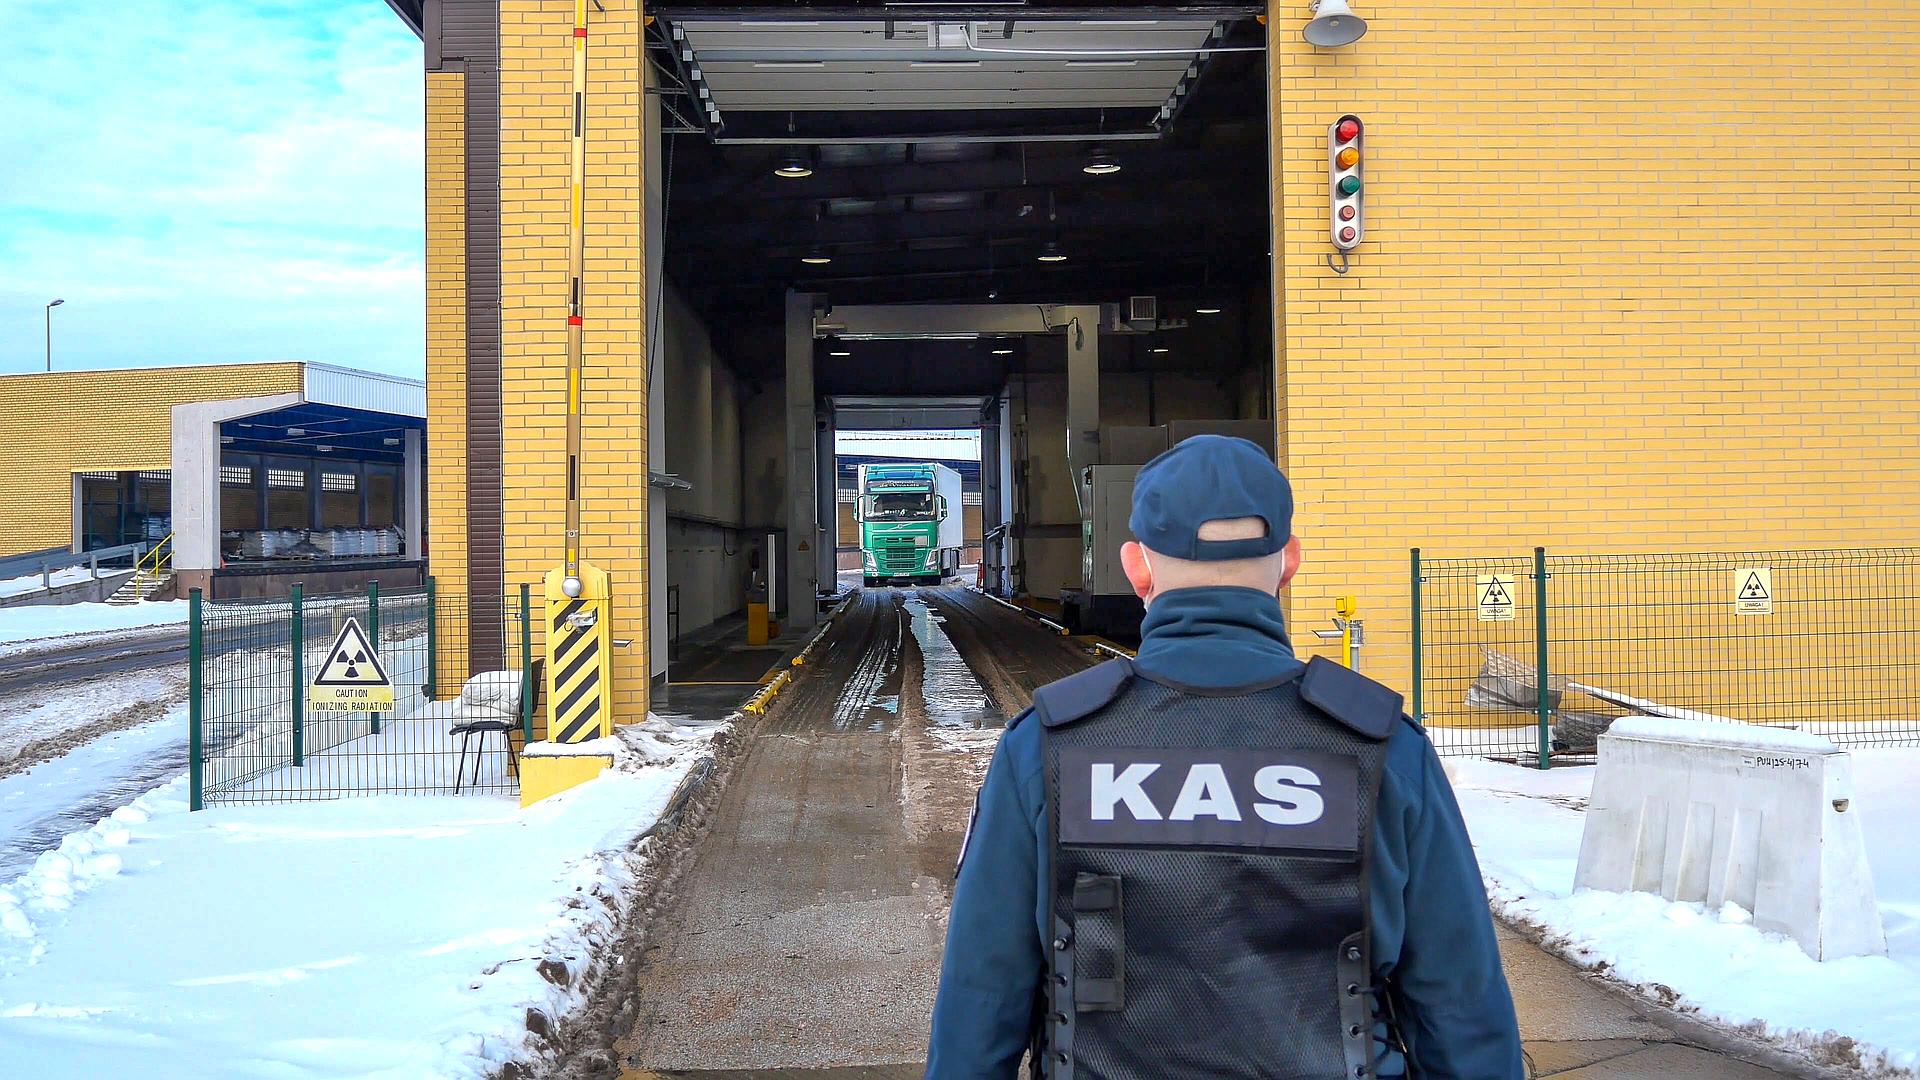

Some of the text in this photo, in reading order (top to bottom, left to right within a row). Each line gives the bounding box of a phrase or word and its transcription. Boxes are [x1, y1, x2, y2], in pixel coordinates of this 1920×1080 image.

[335, 689, 368, 698] CAUTION
[312, 702, 393, 711] IONIZING RADIATION
[1091, 763, 1325, 825] KAS
